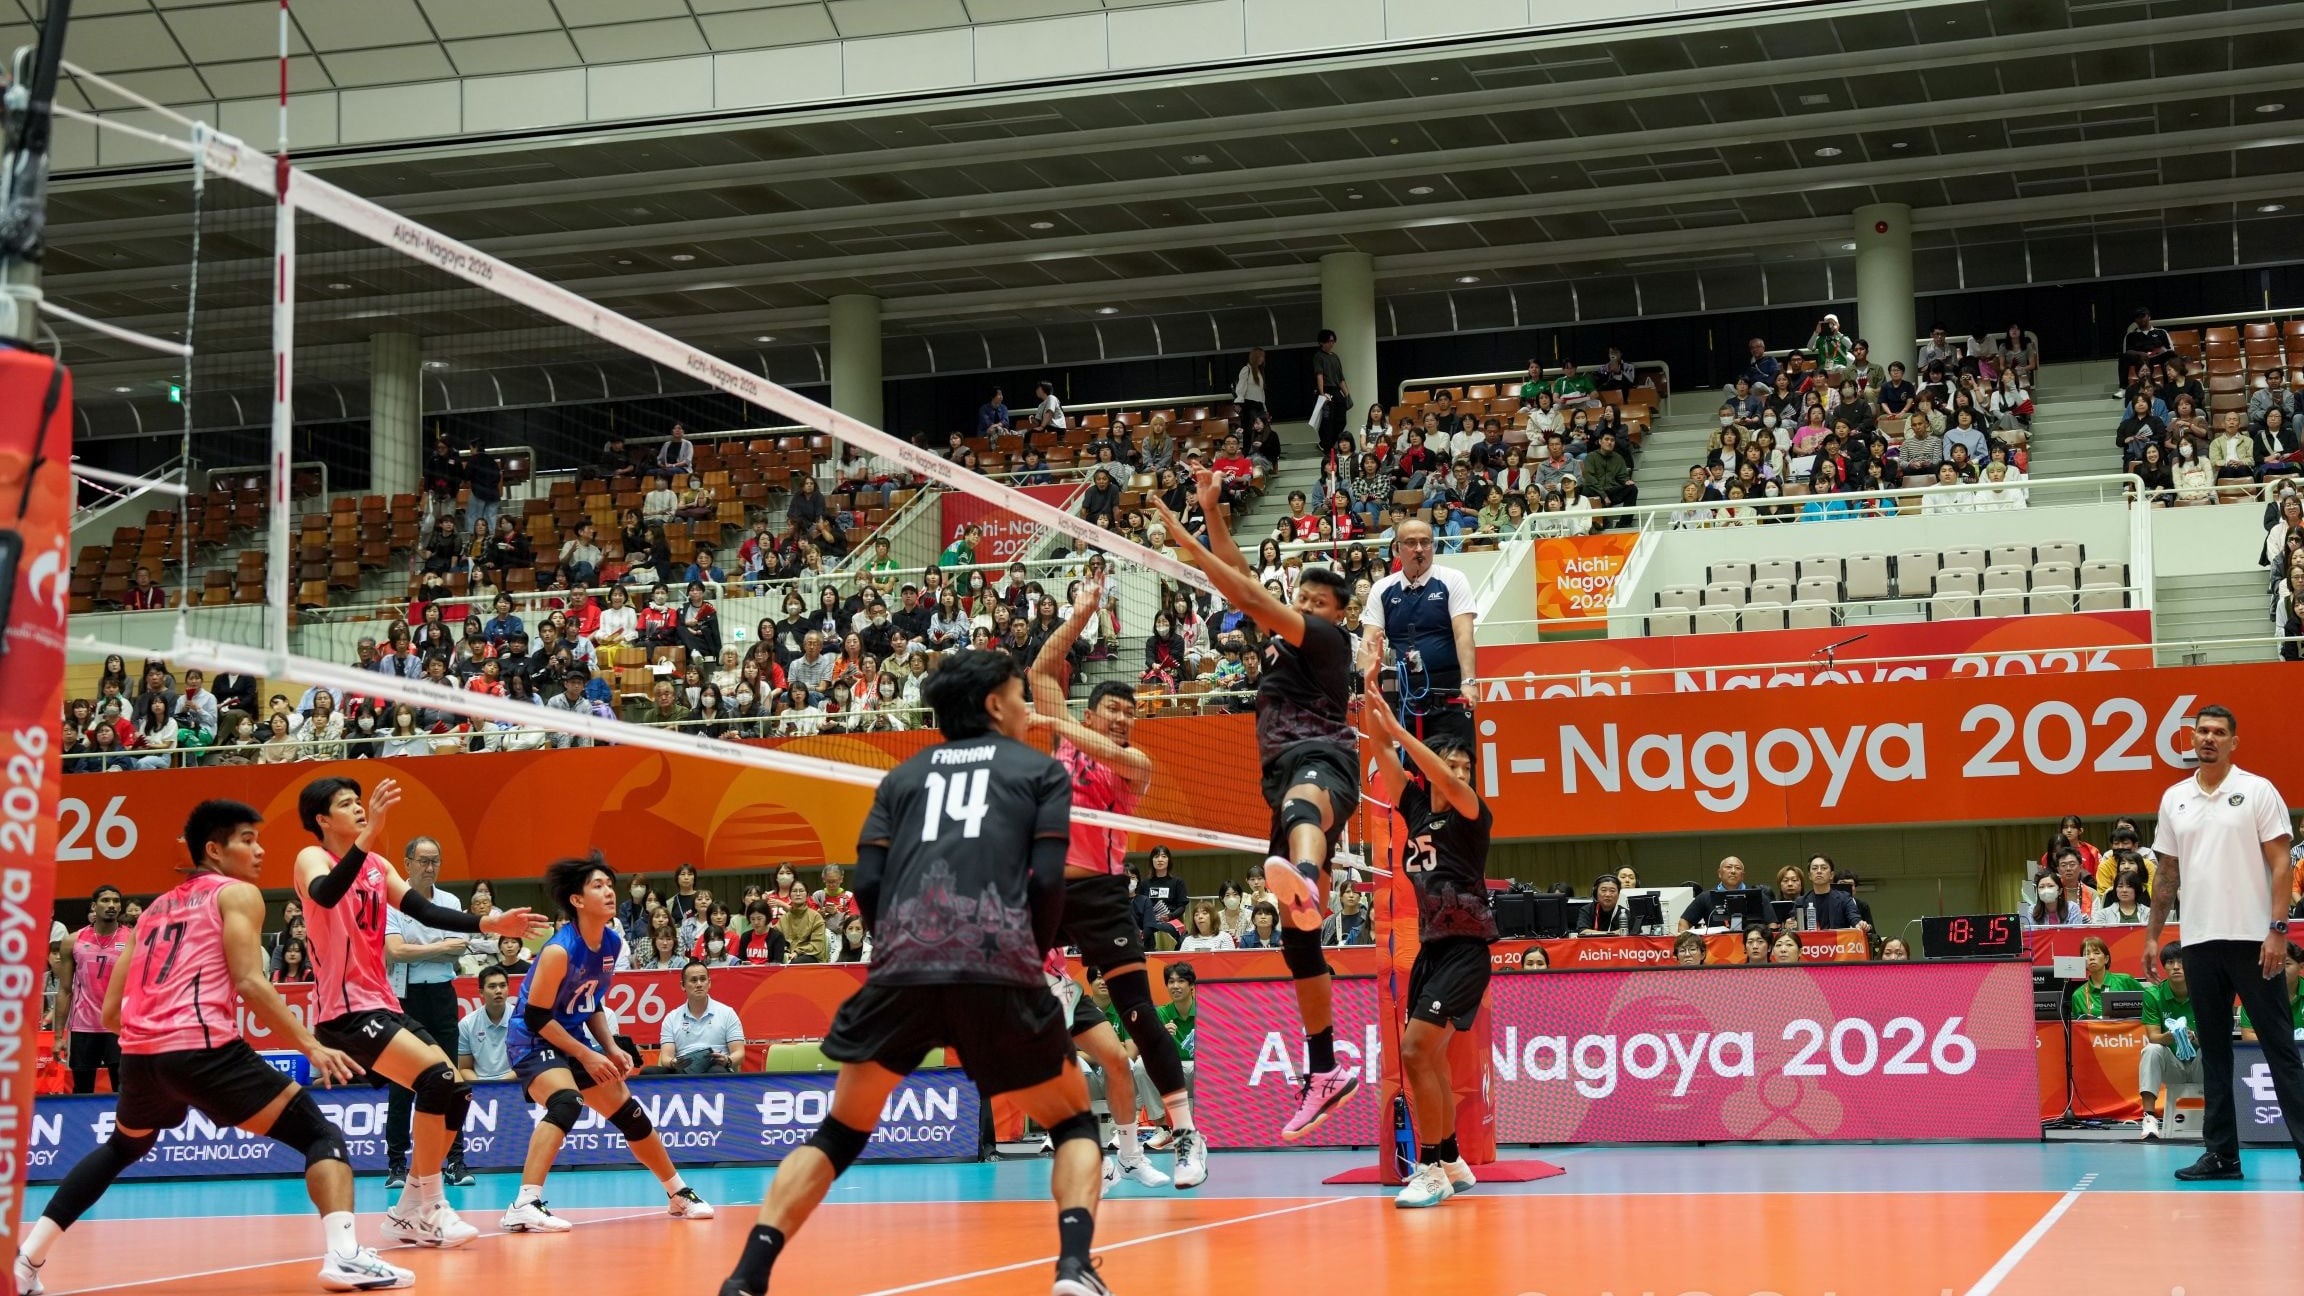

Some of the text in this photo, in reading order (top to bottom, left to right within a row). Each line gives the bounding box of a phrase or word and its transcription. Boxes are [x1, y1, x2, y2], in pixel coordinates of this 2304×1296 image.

[1565, 555, 1618, 574] Aichi-
[931, 745, 996, 764] FARHAN
[1479, 695, 2200, 813] i-Nagoya 2026
[2, 725, 48, 854] 2026
[921, 768, 990, 842] 14
[56, 795, 138, 862] 26
[1406, 834, 1437, 872] 25
[355, 888, 380, 931] 21
[96, 955, 107, 979] 7
[142, 921, 187, 986] 17
[1578, 947, 1670, 963] Aichi-Nagoya
[566, 980, 598, 1014] 13
[608, 983, 666, 1024] 26
[362, 1019, 384, 1039] 21
[1781, 1016, 1977, 1076] 2026
[540, 1049, 555, 1062] 13
[163, 1143, 275, 1162] TECHNOLOGY
[760, 1126, 956, 1146] SPORT HNOLOGY
